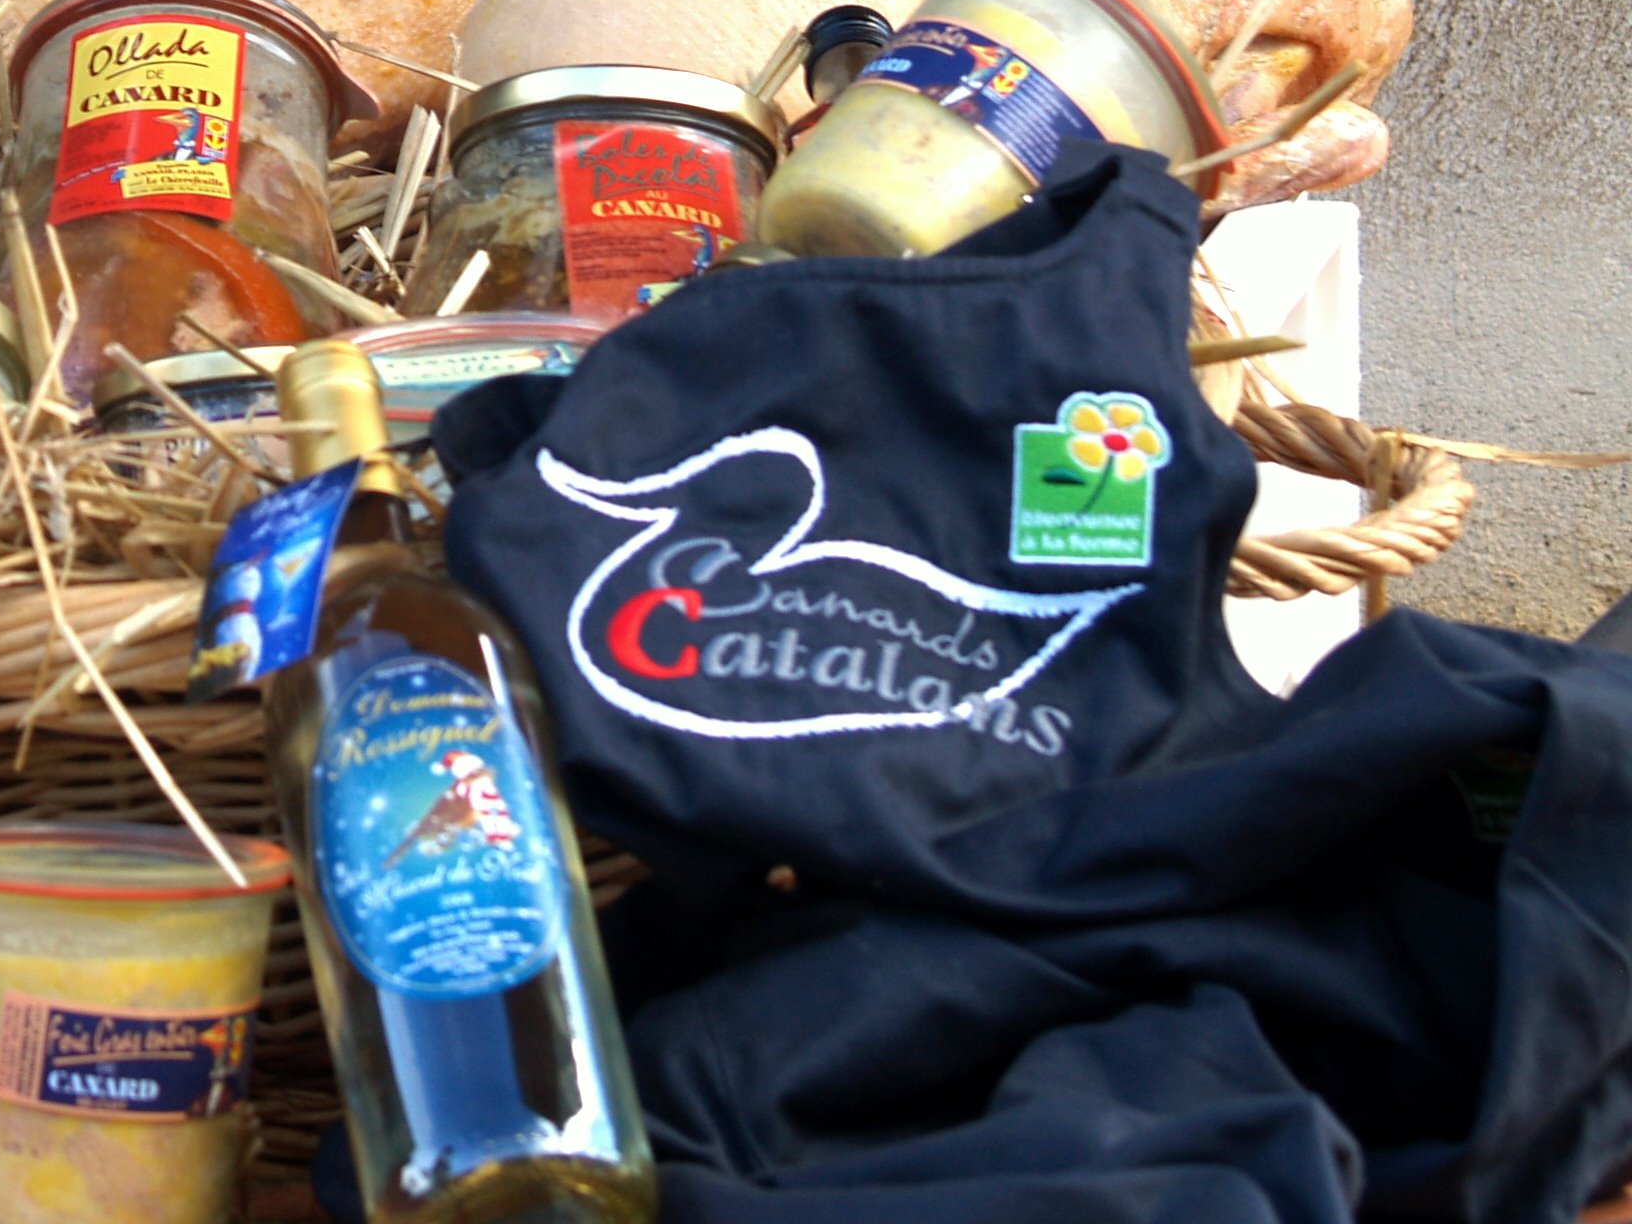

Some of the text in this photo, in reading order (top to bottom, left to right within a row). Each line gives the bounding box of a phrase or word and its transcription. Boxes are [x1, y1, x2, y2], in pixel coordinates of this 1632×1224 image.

[88, 28, 209, 77] Ollada
[145, 68, 165, 79] DE
[79, 84, 222, 113] CANARD
[591, 199, 723, 230] CANARD
[1041, 532, 1065, 551] la
[1069, 532, 1140, 553] ferme
[648, 537, 1000, 671] Canards
[606, 587, 1073, 757] Catalans
[46, 1069, 161, 1102] CANARD
